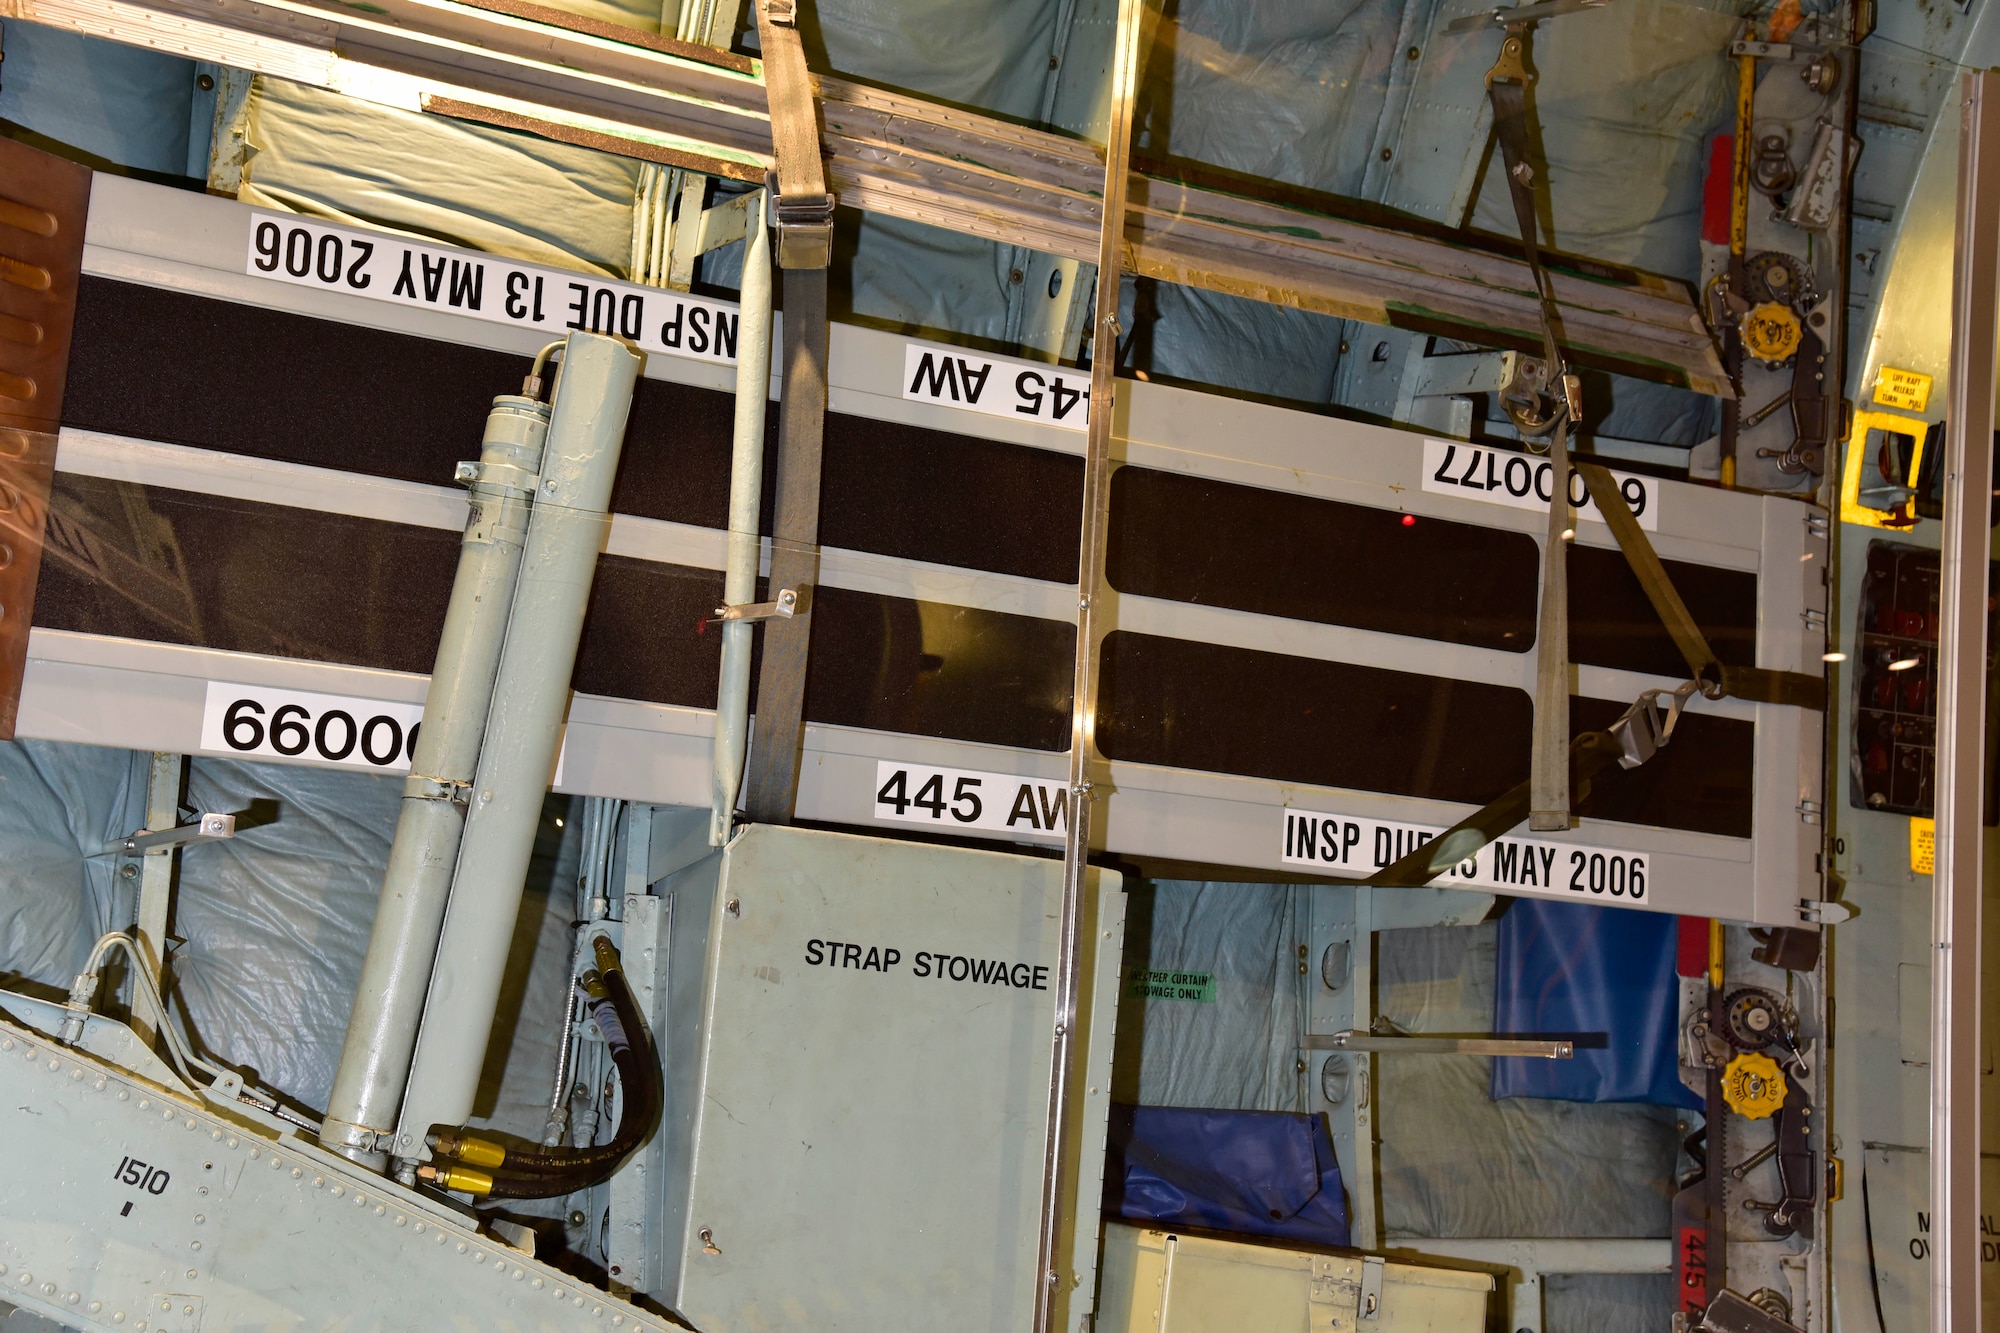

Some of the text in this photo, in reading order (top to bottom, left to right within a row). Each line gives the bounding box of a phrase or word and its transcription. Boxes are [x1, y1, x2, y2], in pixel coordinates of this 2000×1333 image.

[255, 222, 739, 359] NSP DUE 13 MAY 2006
[1781, 321, 1793, 346] LOCK
[909, 352, 992, 404] AW
[1893, 385, 1915, 396] RELEASE
[1882, 393, 1898, 403] TURN
[1434, 445, 1646, 518] 6000177
[877, 770, 982, 823] 445
[1286, 815, 1360, 863] INSP
[1493, 841, 1556, 887] MAY
[1569, 851, 1645, 899] 2006
[805, 939, 1049, 990] STRAP STOWAGE
[1171, 973, 1208, 986] CURTAIN
[1134, 985, 1201, 1000] STOWAGE ONLY
[1733, 1067, 1745, 1102] UNLOCK
[1767, 1075, 1777, 1102] LOCK
[114, 1156, 170, 1195] 1510
[1685, 1235, 1706, 1289] 445
